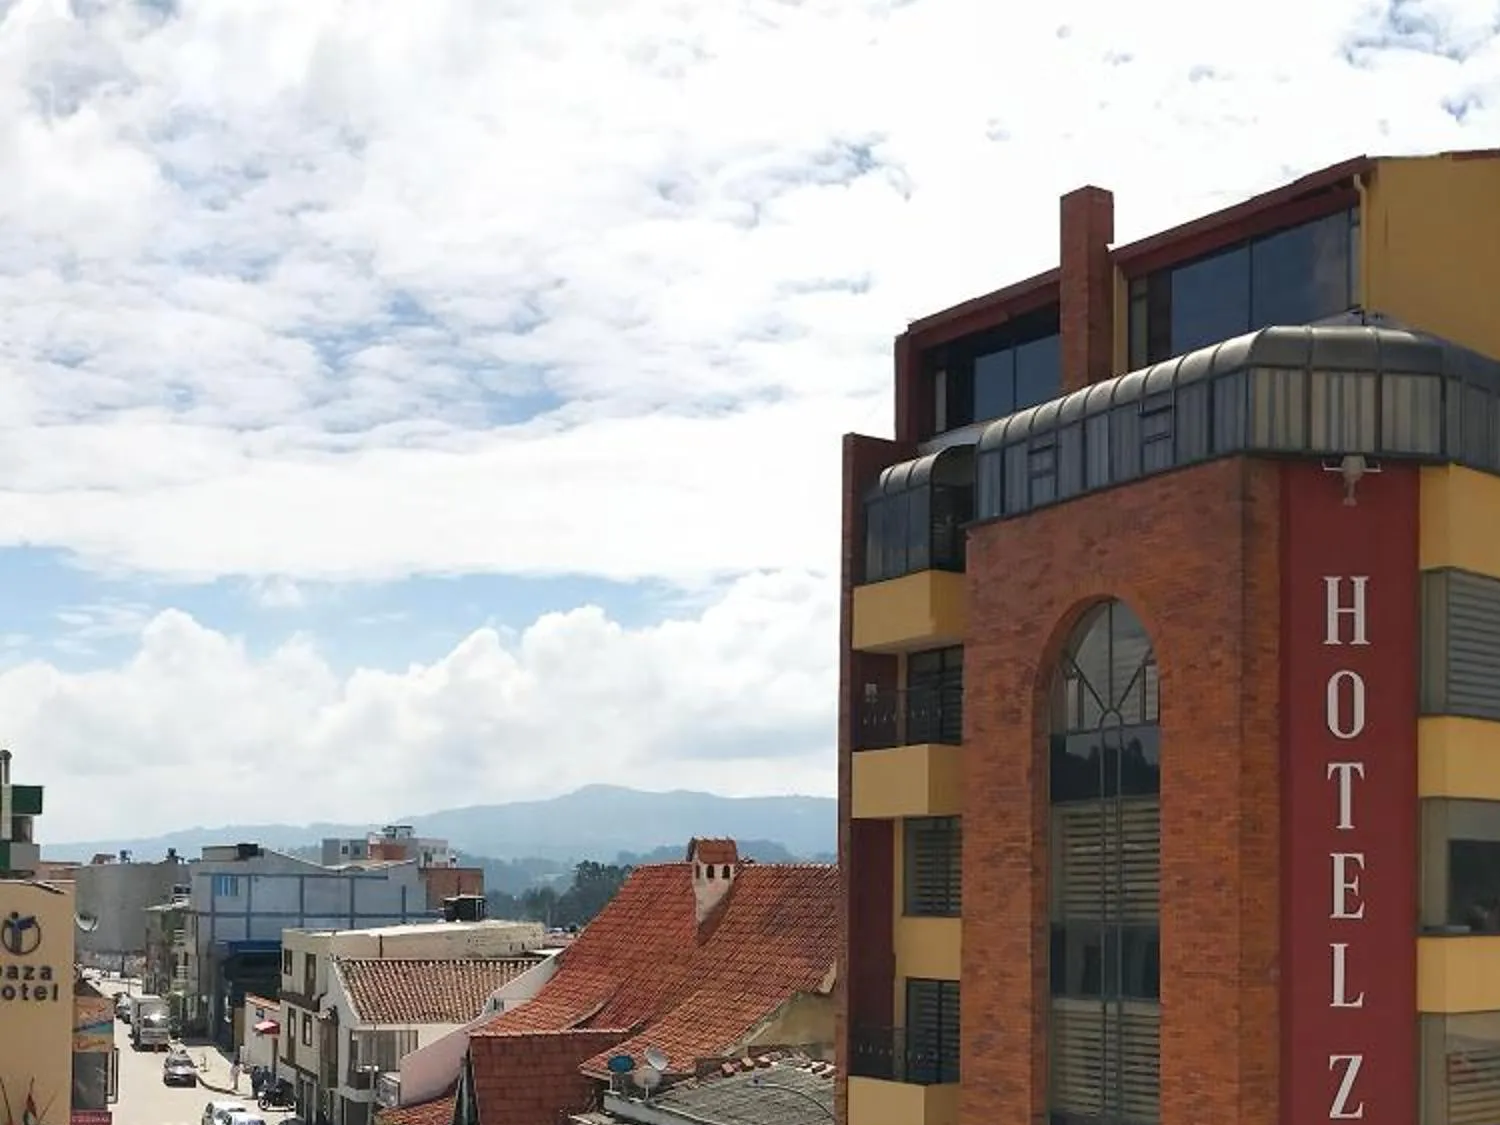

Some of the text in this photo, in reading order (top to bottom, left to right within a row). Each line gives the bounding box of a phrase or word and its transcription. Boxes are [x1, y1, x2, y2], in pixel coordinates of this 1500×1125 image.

[1322, 575, 1371, 1008] HOTEL
[0, 965, 53, 981] aza
[0, 982, 59, 1001] otel
